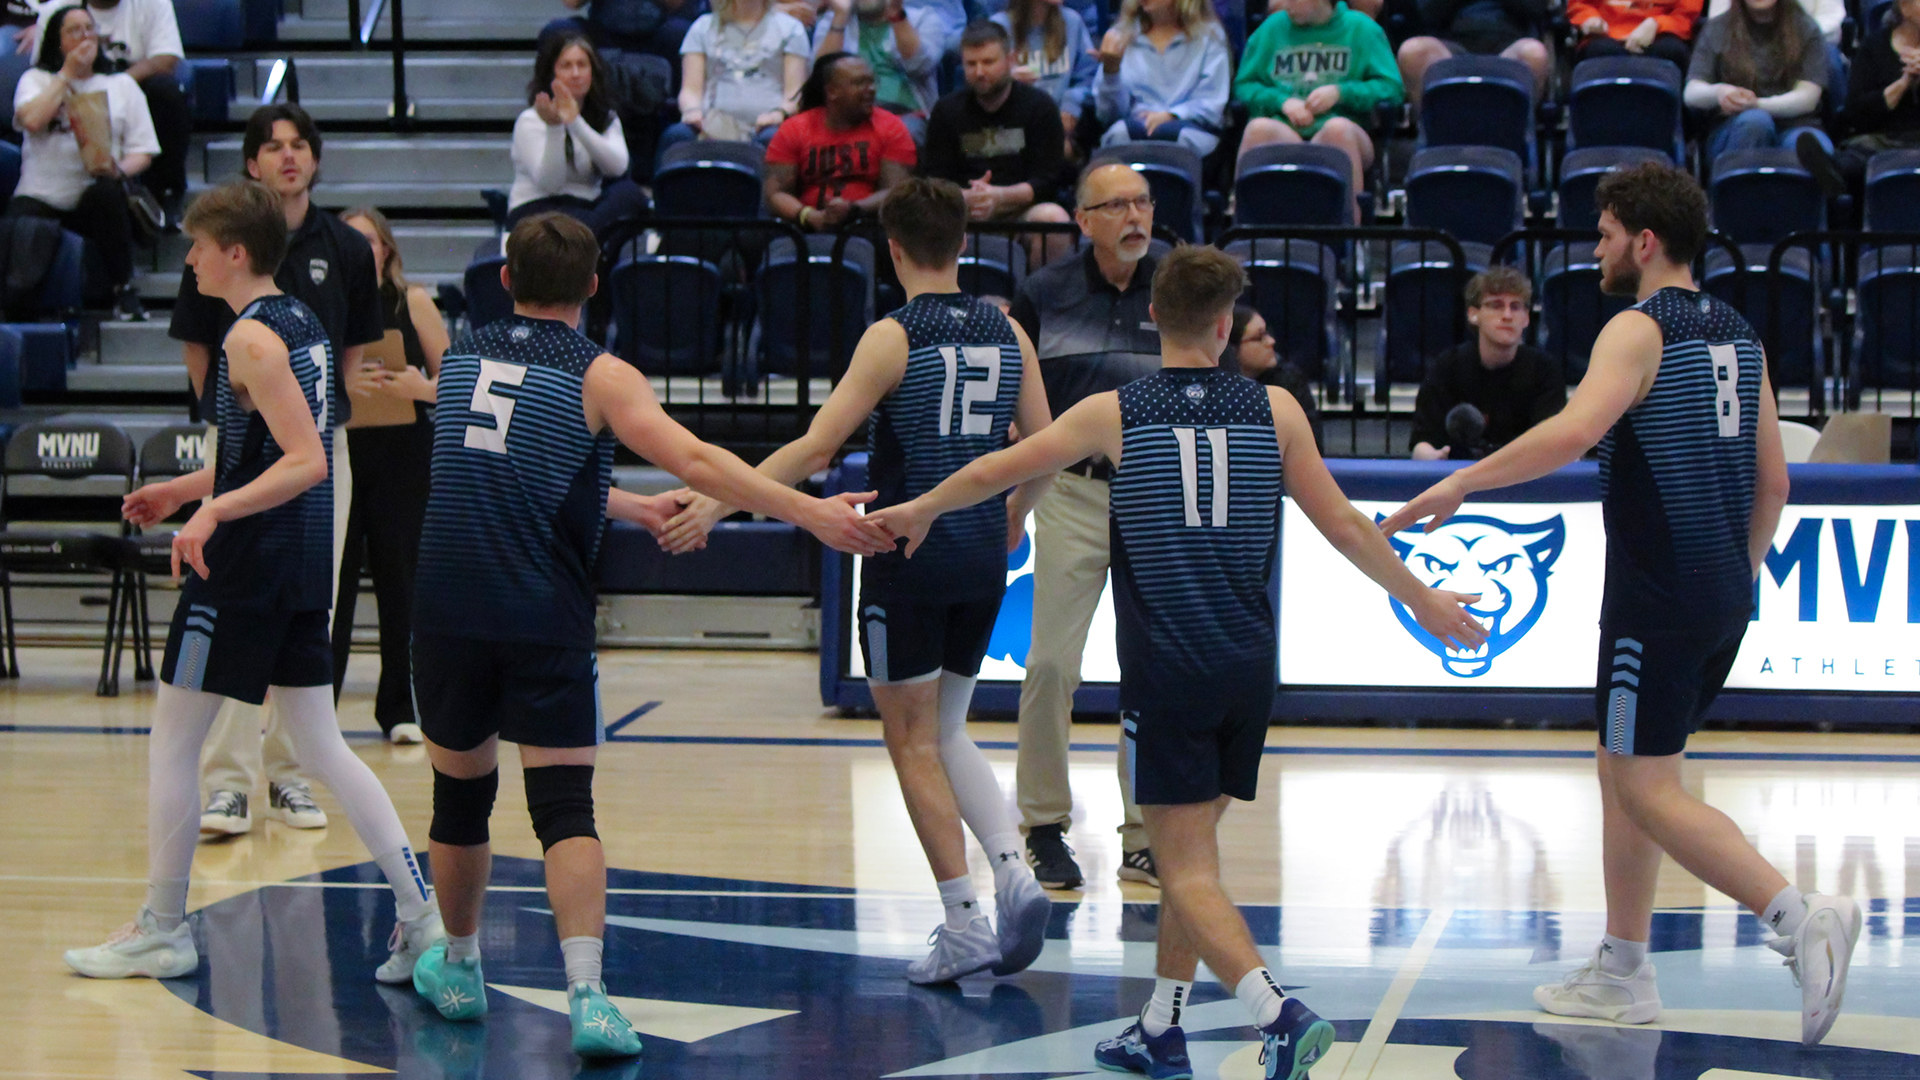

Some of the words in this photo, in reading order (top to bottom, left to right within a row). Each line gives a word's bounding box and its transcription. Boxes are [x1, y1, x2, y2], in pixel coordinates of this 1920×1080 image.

[1274, 51, 1347, 75] MVNU
[805, 141, 869, 175] JUST
[309, 344, 328, 432] 3
[464, 359, 527, 454] 5
[939, 346, 1000, 435] 12
[1707, 344, 1740, 437] 8
[38, 433, 99, 457] MVNU
[1171, 427, 1228, 527] 11
